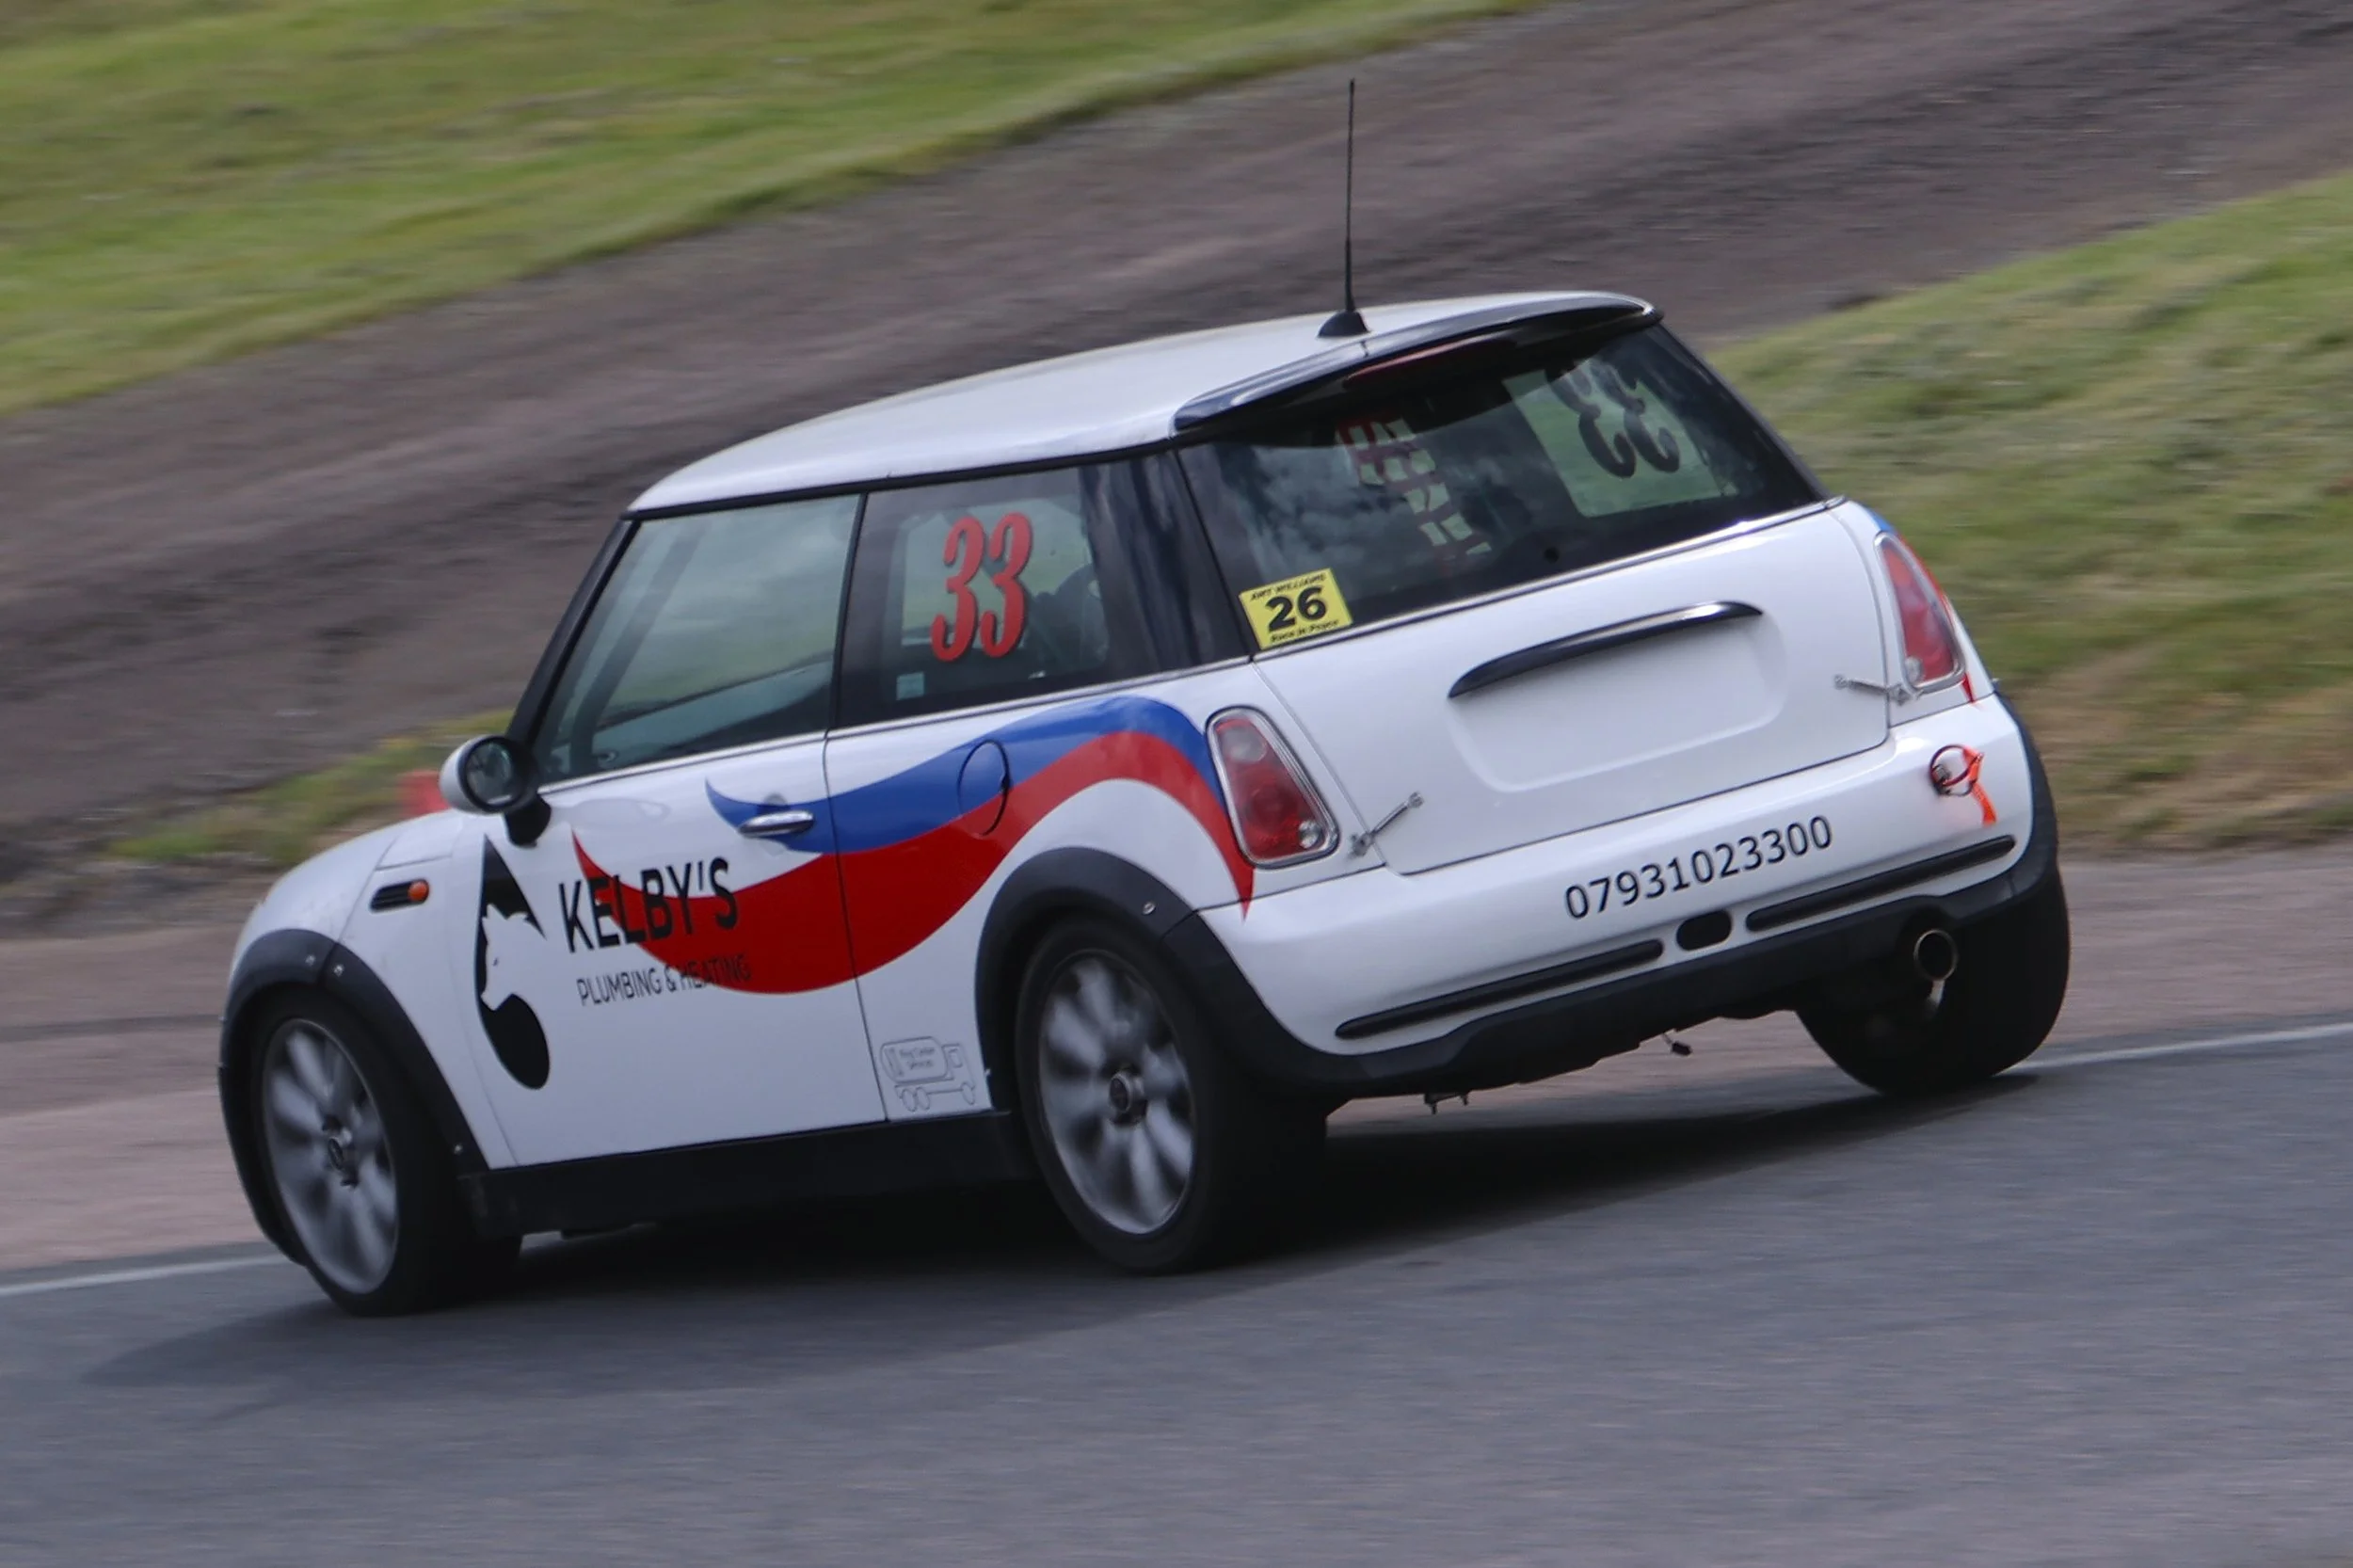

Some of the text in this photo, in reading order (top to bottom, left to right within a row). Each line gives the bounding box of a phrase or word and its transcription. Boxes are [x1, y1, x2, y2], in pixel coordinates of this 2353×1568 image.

[930, 511, 1032, 663] 33
[1266, 586, 1327, 632] 26
[558, 856, 739, 953] KELBY'S
[1564, 815, 1833, 919] 07931023300
[576, 953, 752, 1007] PLUMBING & HEATING
